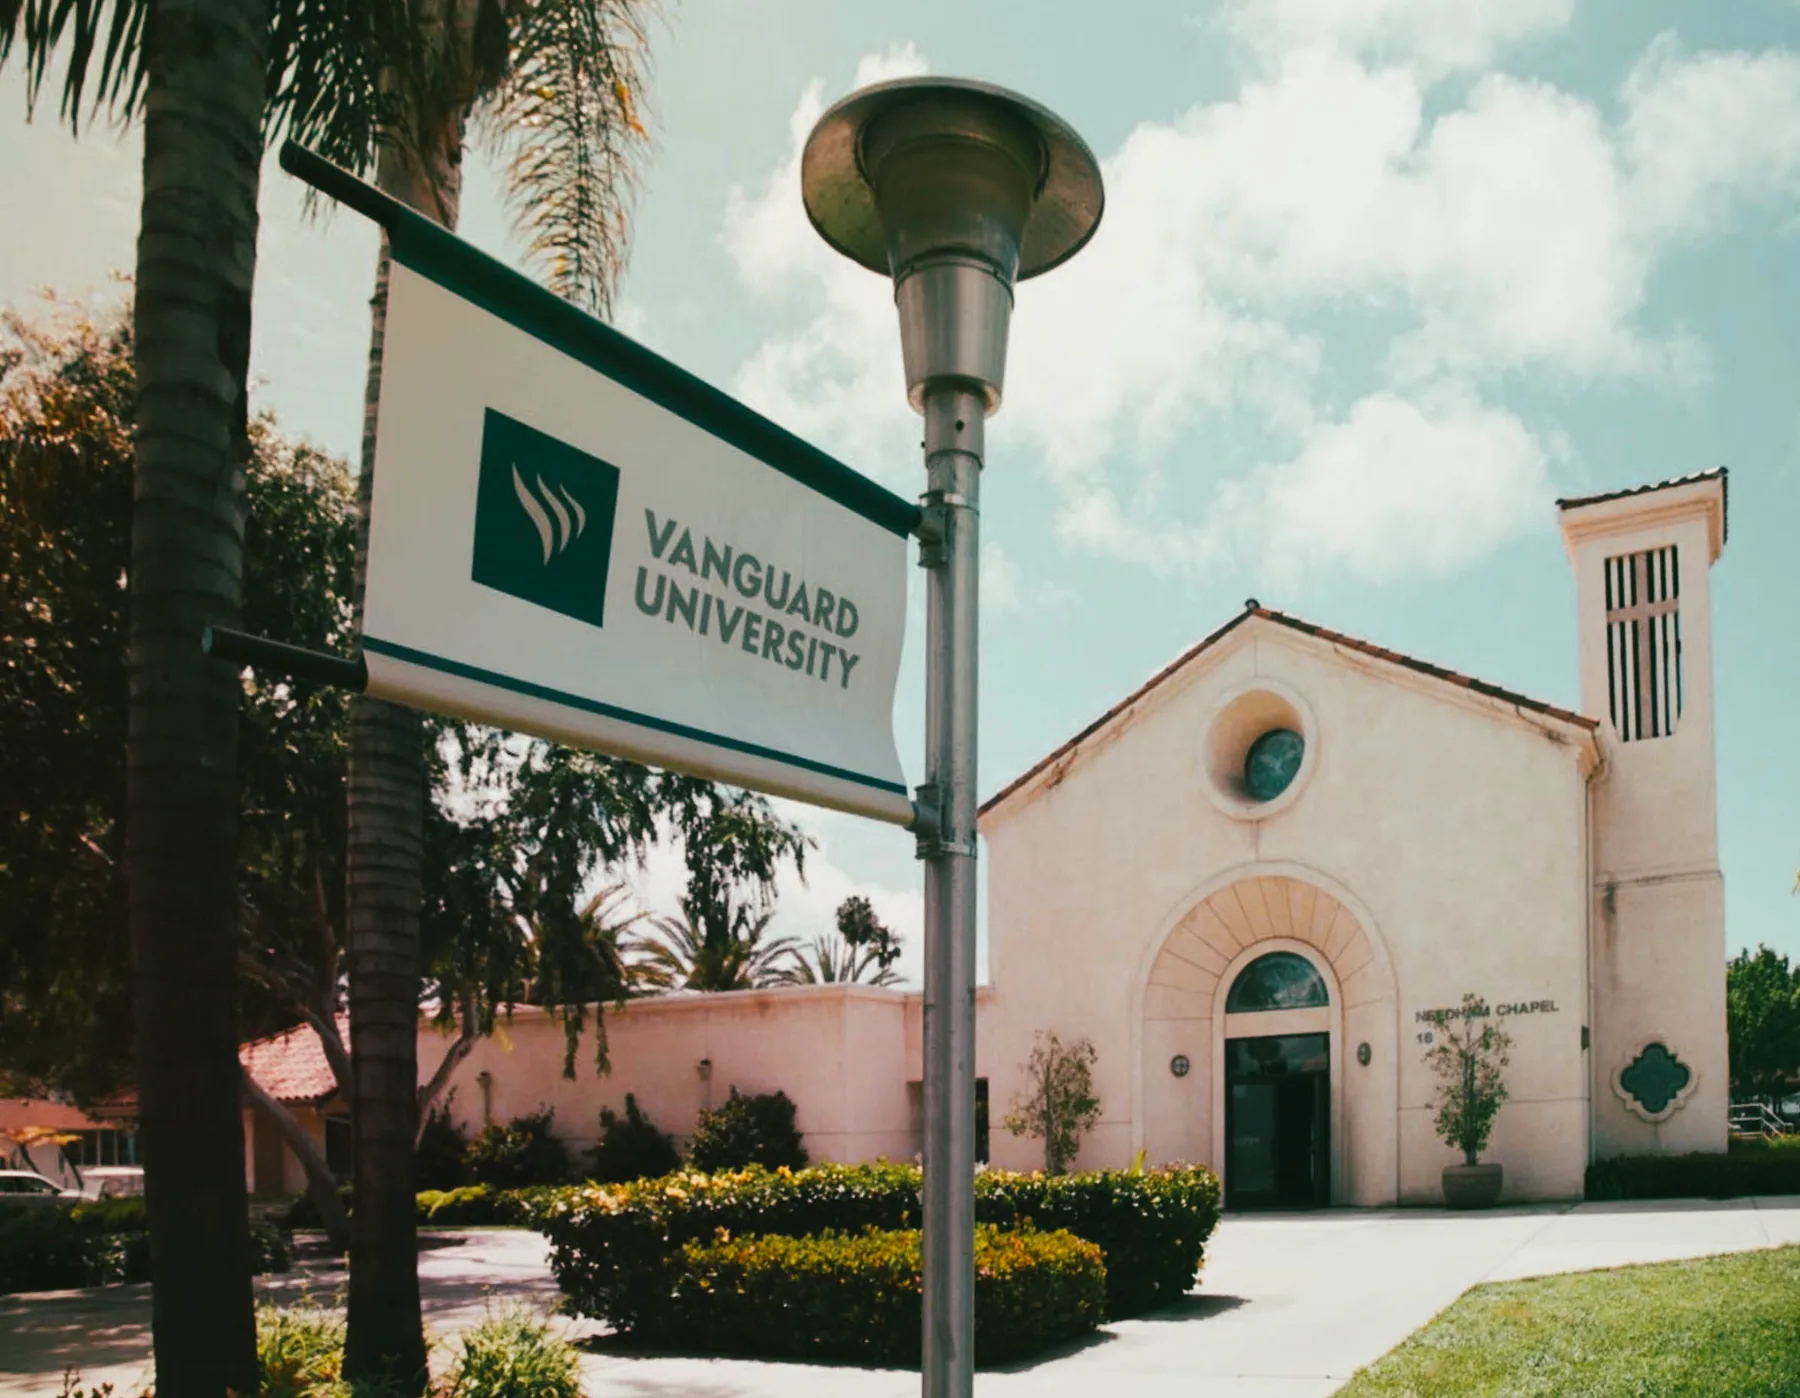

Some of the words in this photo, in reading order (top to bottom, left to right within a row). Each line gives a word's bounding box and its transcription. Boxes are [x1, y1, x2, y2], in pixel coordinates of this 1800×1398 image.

[635, 566, 860, 689] UNIVERSITY
[645, 508, 859, 638] VANGUARD
[1496, 1000, 1559, 1017] CHAPEL
